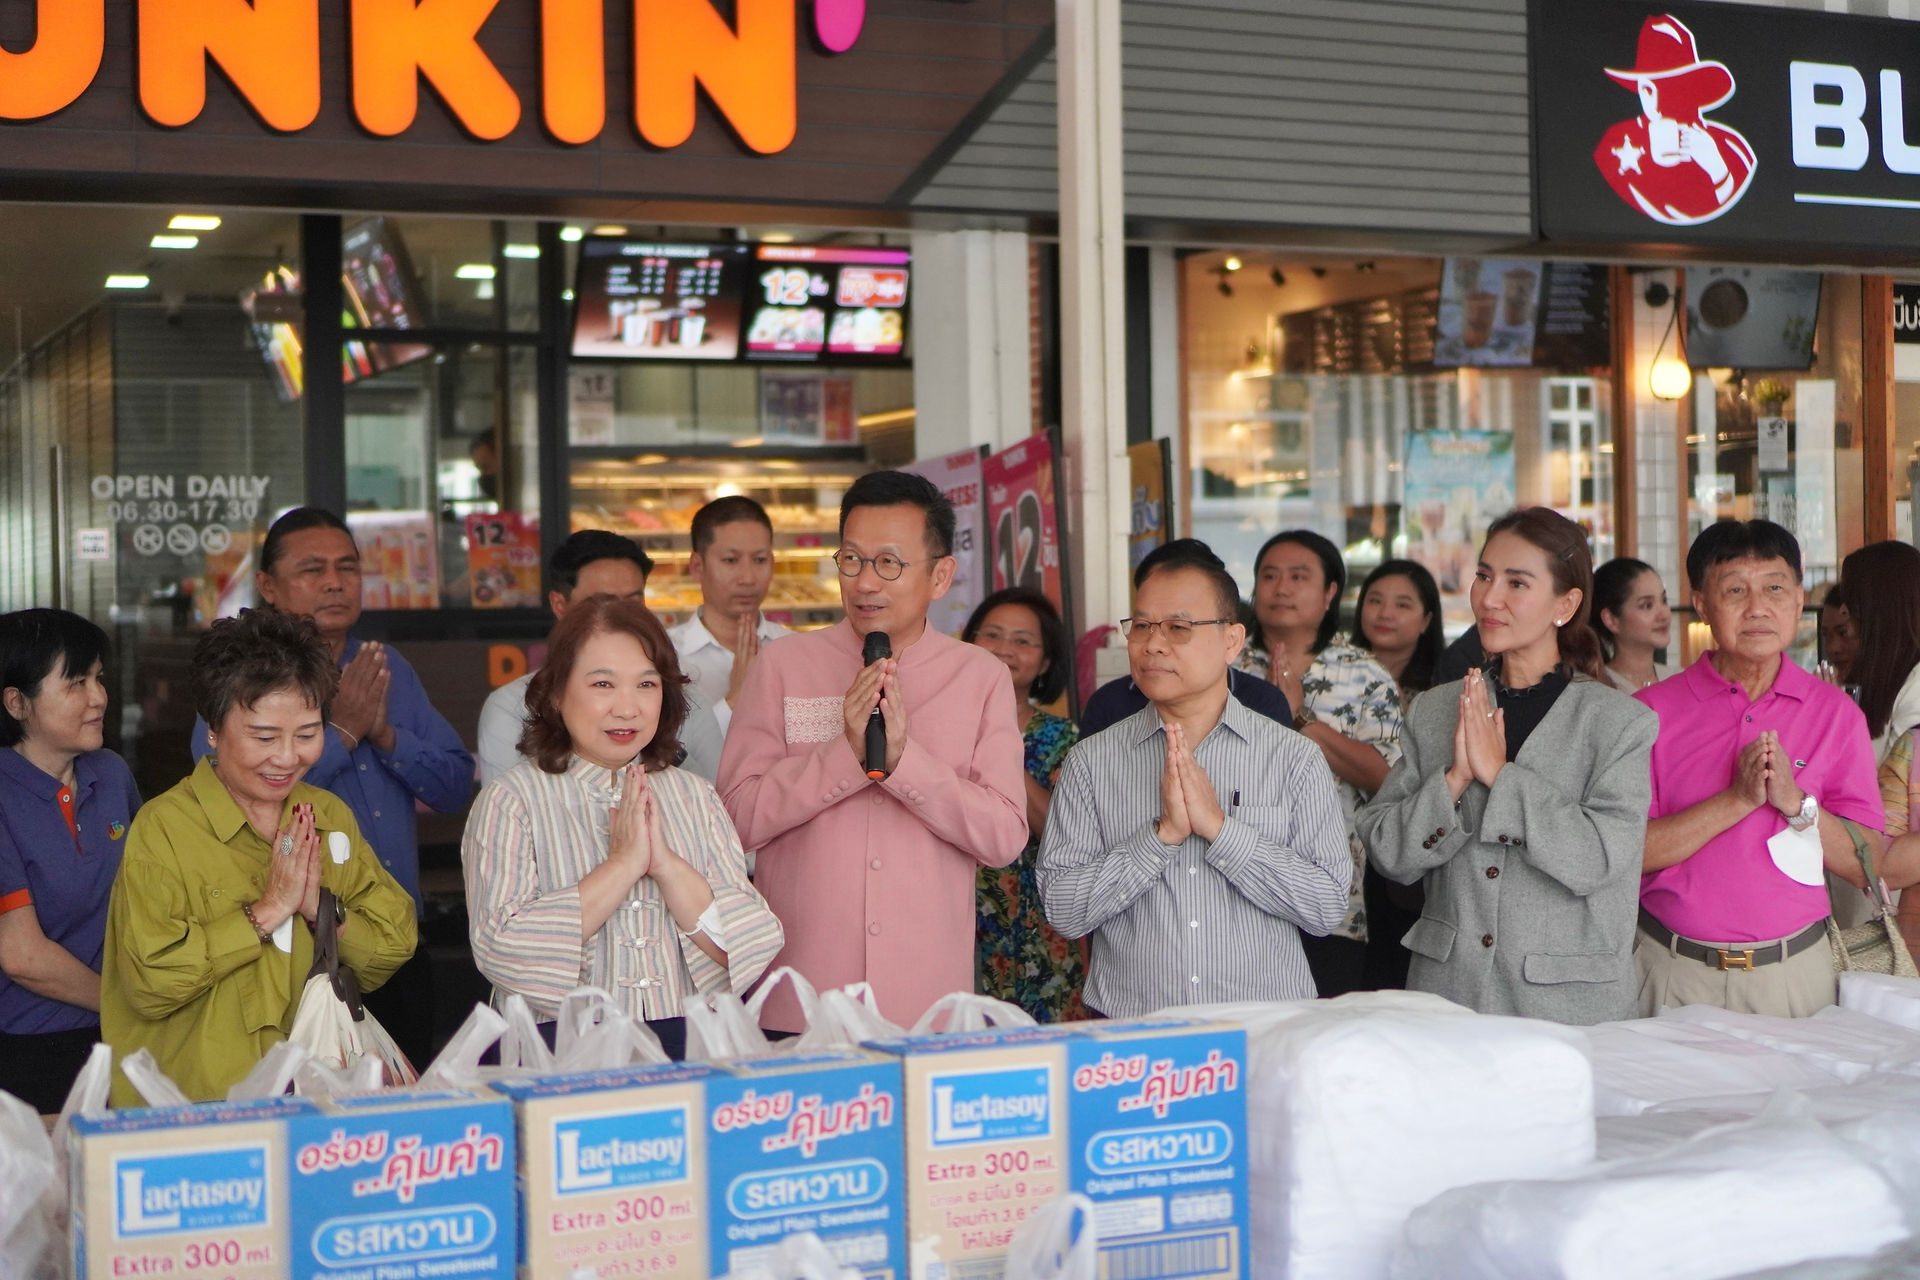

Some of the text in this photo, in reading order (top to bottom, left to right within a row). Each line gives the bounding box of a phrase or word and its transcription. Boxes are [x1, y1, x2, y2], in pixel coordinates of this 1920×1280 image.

[761, 267, 809, 305] 12
[91, 475, 269, 498] OPEN DAILY
[108, 501, 258, 521] 06.30-17.30
[475, 522, 505, 546] 12
[1075, 1051, 1147, 1091] อร่อย
[713, 1089, 793, 1131] อร่อย
[936, 1085, 1046, 1141] Lactasoy
[297, 1128, 388, 1174] อร่อย
[559, 1130, 683, 1189] Lactasoy
[927, 1164, 976, 1181] Extra
[984, 1151, 1029, 1175] 300
[1102, 1131, 1215, 1165] รสหวาน
[121, 1168, 263, 1232] Lactasoy
[746, 1170, 868, 1209] รสหวาน
[553, 1212, 605, 1232] Extra
[616, 1196, 664, 1223] 300
[334, 1216, 474, 1257] รสหวาน
[113, 1255, 173, 1276] Extra
[185, 1240, 240, 1269] 300
